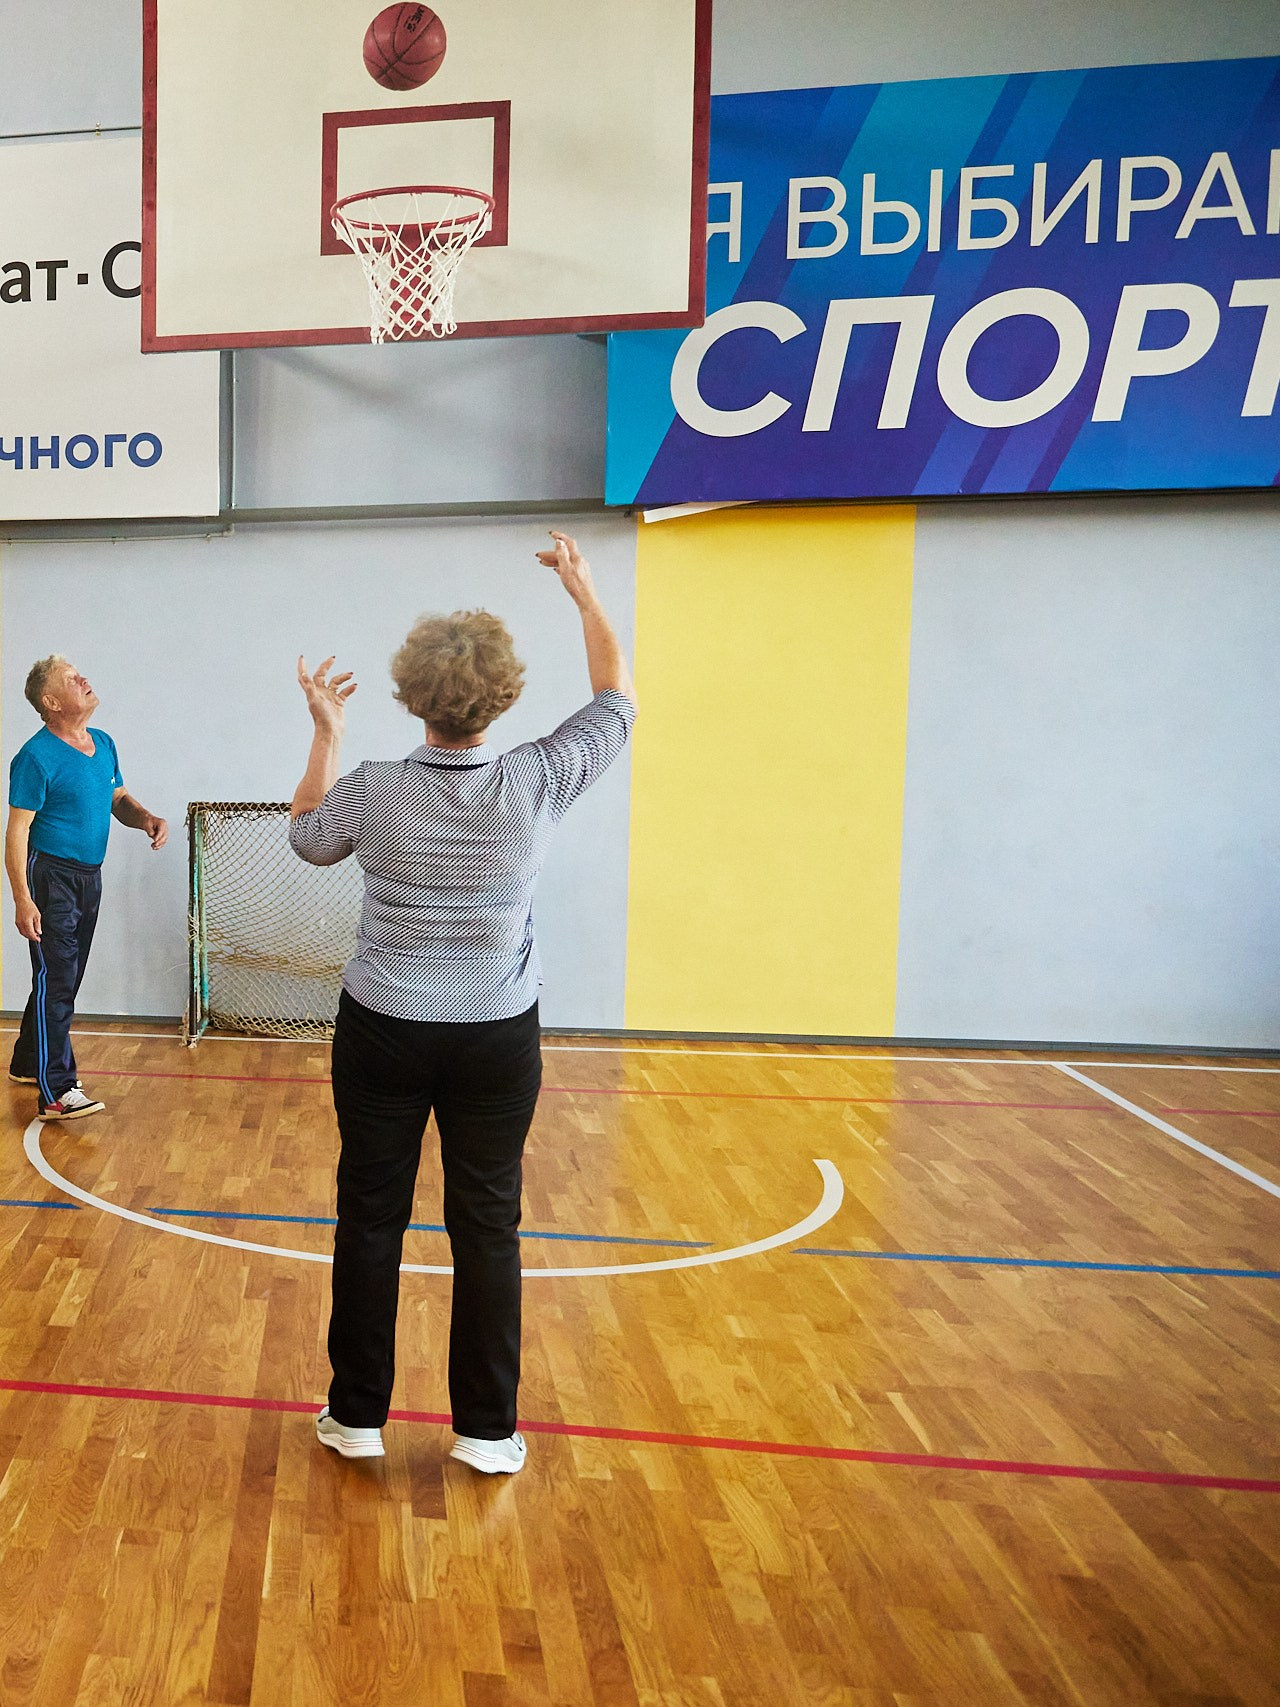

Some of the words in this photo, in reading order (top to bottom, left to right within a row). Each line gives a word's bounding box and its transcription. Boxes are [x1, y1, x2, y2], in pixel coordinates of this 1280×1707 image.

[706, 181, 743, 263] Я
[786, 148, 1280, 260] ВЫБИРА
[669, 277, 1280, 437] СПОРТ
